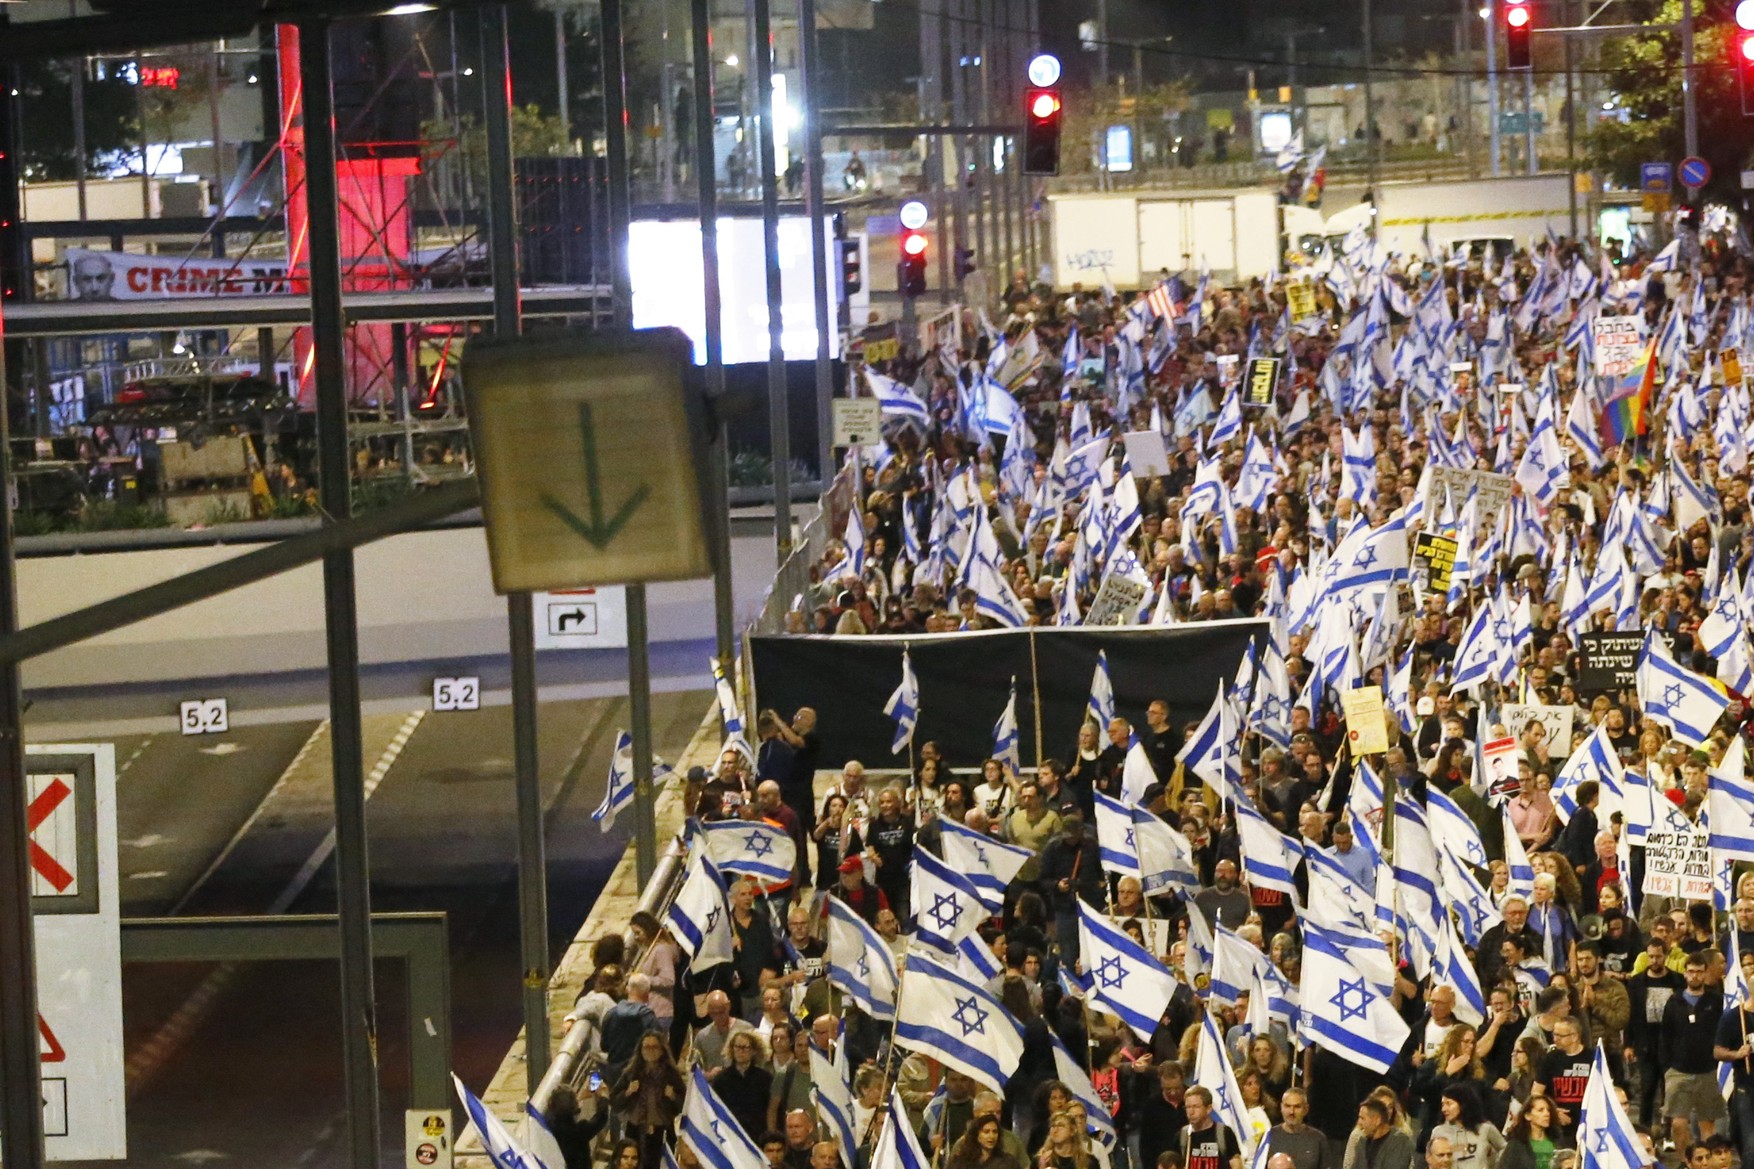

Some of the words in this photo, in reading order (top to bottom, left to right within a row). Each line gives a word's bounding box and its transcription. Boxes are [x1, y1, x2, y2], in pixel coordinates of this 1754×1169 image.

[127, 266, 246, 295] CRIME
[438, 683, 474, 705] 5.2
[186, 706, 222, 729] 5.2
